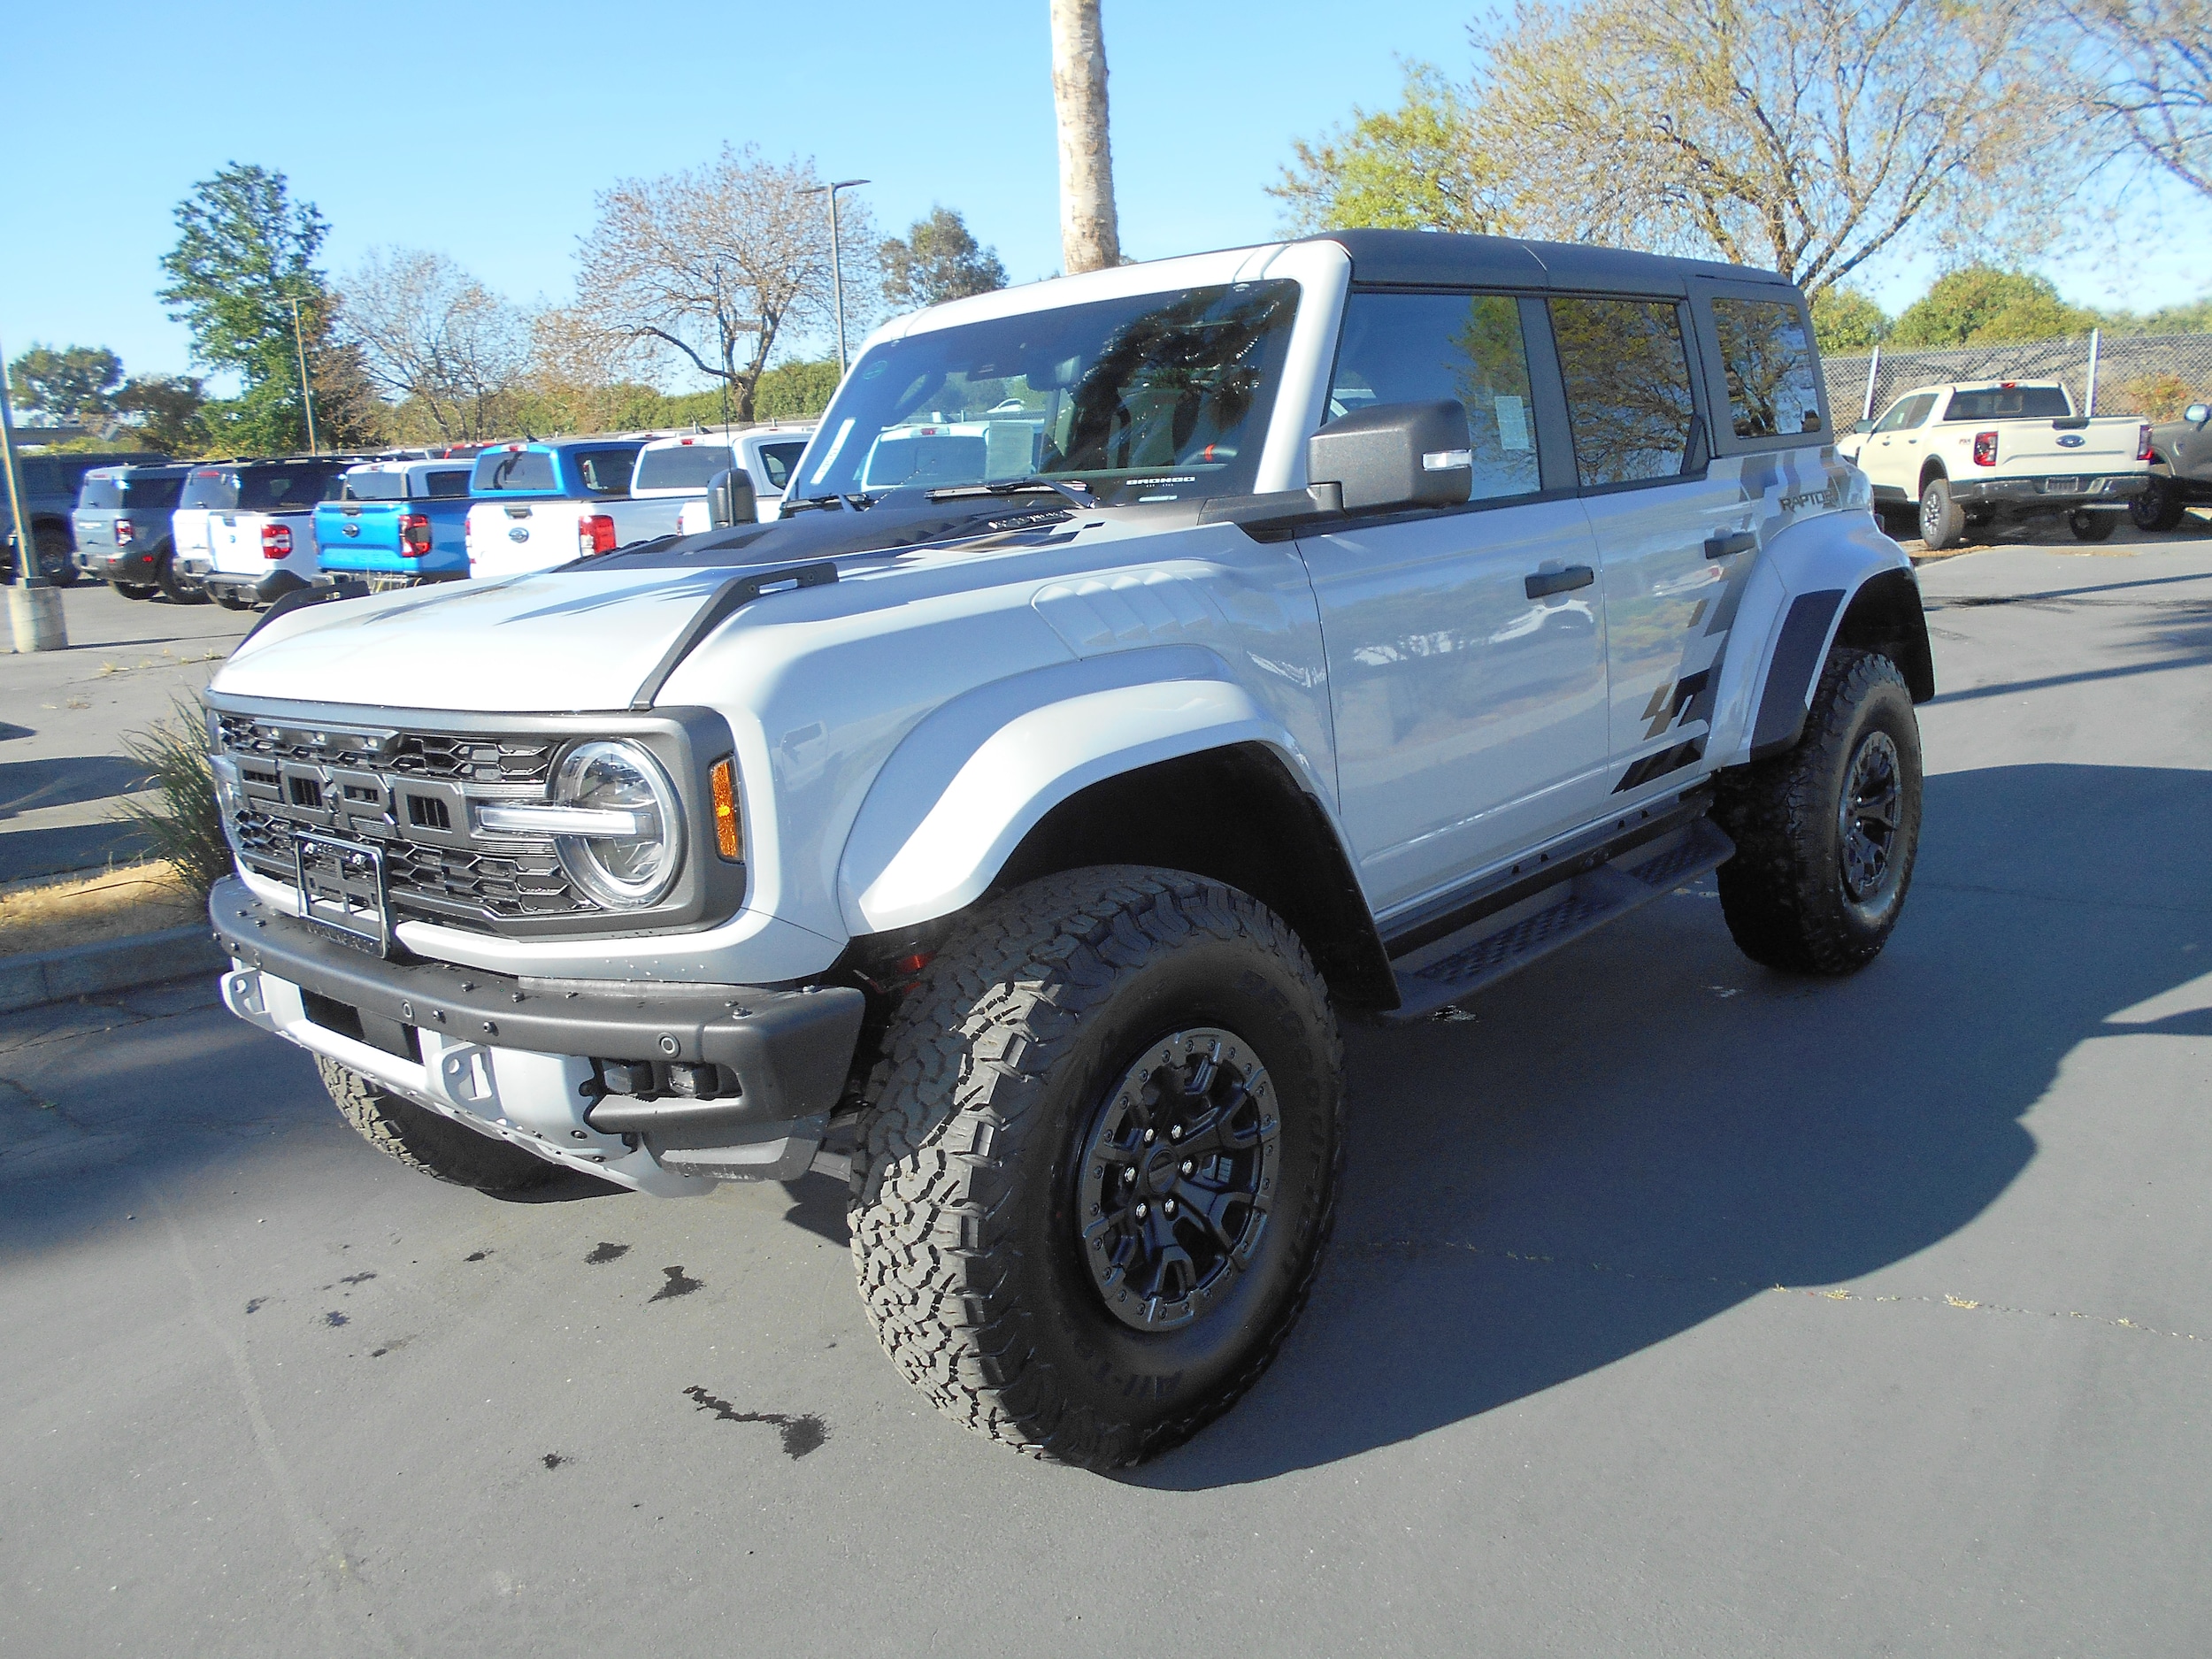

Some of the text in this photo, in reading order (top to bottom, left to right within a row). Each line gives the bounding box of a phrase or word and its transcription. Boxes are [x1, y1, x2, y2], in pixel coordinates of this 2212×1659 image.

[1125, 476, 1195, 486] BRONCO
[1778, 489, 1838, 512] RAPTOR
[236, 754, 473, 850] FORD
